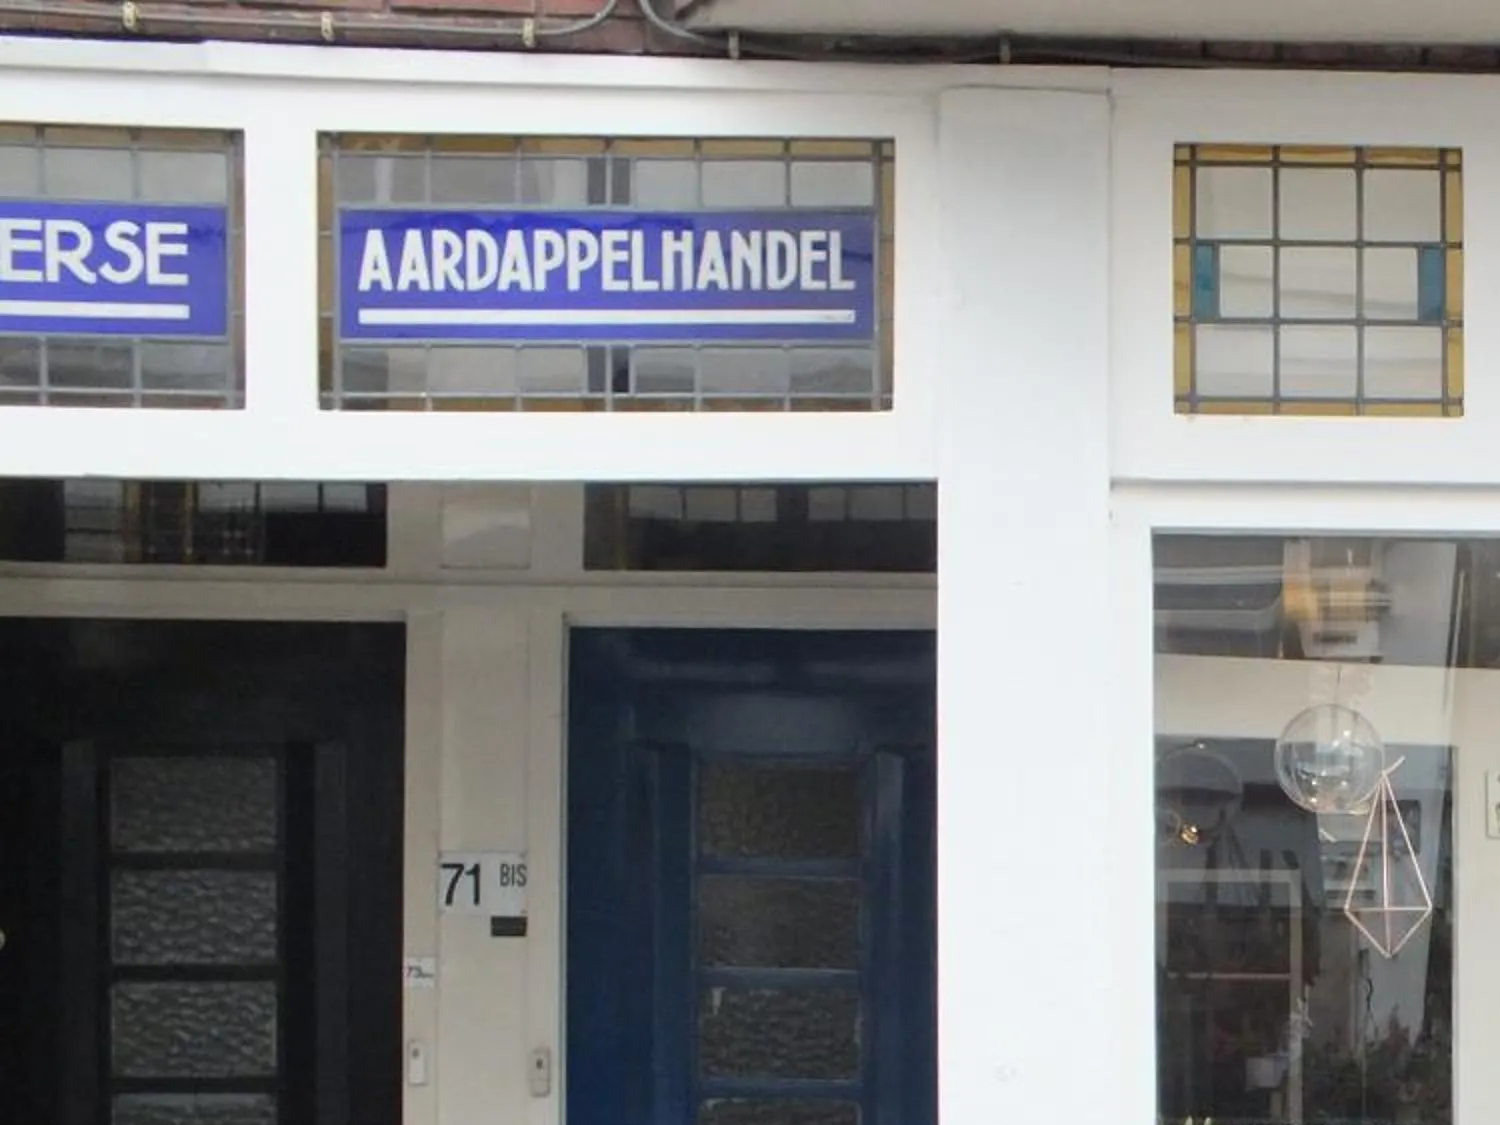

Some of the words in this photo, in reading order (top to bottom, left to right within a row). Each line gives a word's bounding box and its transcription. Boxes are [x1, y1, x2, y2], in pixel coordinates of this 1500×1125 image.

[0, 218, 190, 286] ERSE
[359, 229, 856, 292] AARDAPPELHANDEL
[441, 863, 480, 906] 71
[500, 863, 527, 887] BIS
